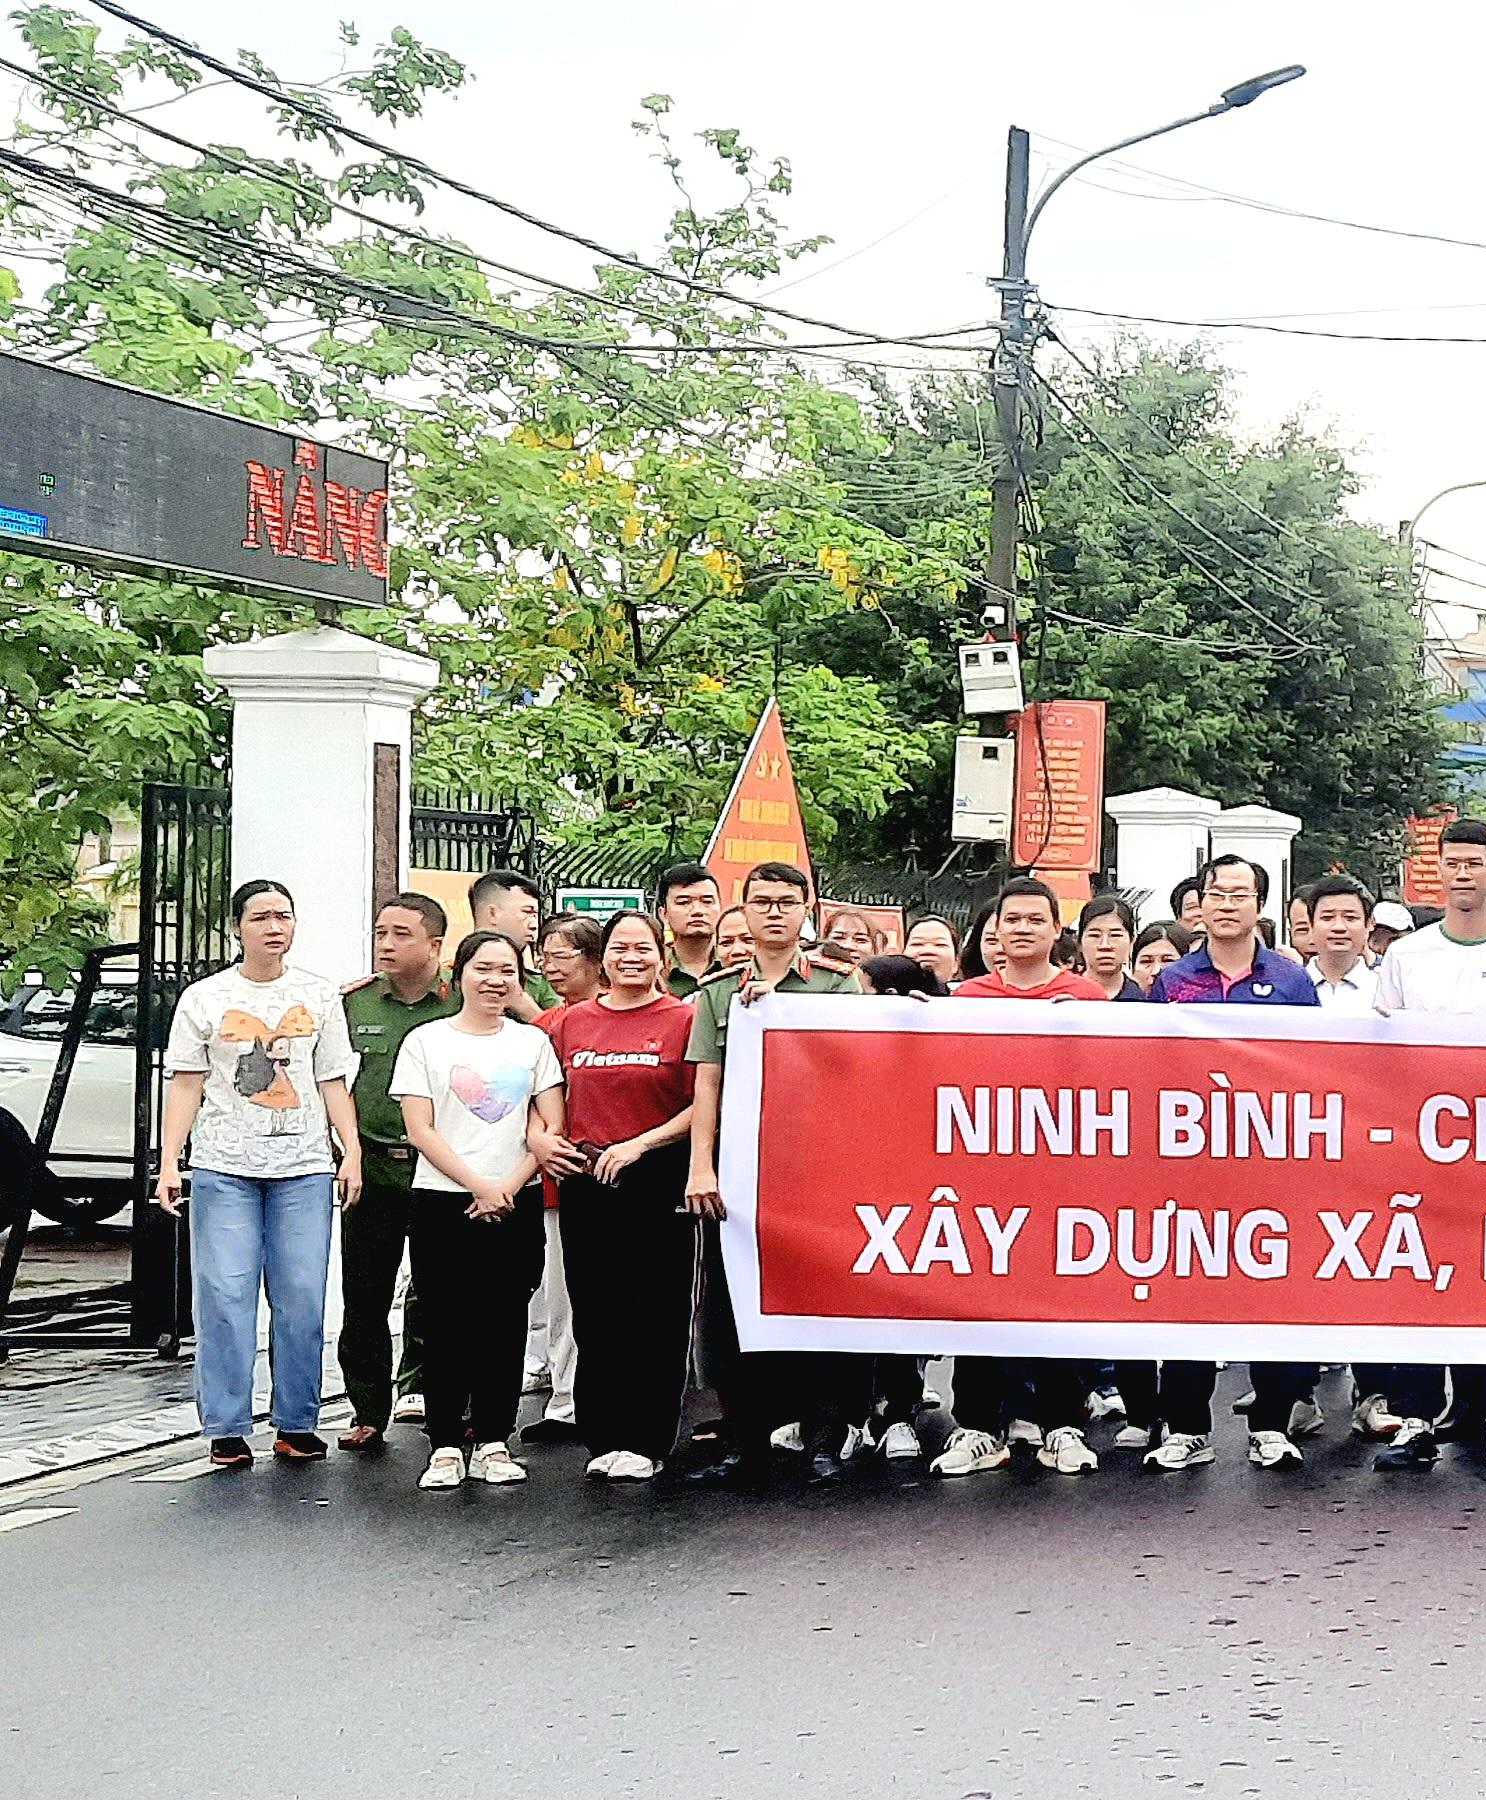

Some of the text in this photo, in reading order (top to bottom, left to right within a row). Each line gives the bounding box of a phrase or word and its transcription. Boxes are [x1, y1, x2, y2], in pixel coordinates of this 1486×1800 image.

[572, 1050, 660, 1068] Vietnam
[937, 1087, 1129, 1156] NINH
[1160, 1073, 1343, 1160] BÌNH
[1369, 1128, 1392, 1142] -
[853, 1186, 1031, 1275] XÂY
[1056, 1199, 1289, 1300] DỰNG
[1315, 1193, 1454, 1291] XÃ,
